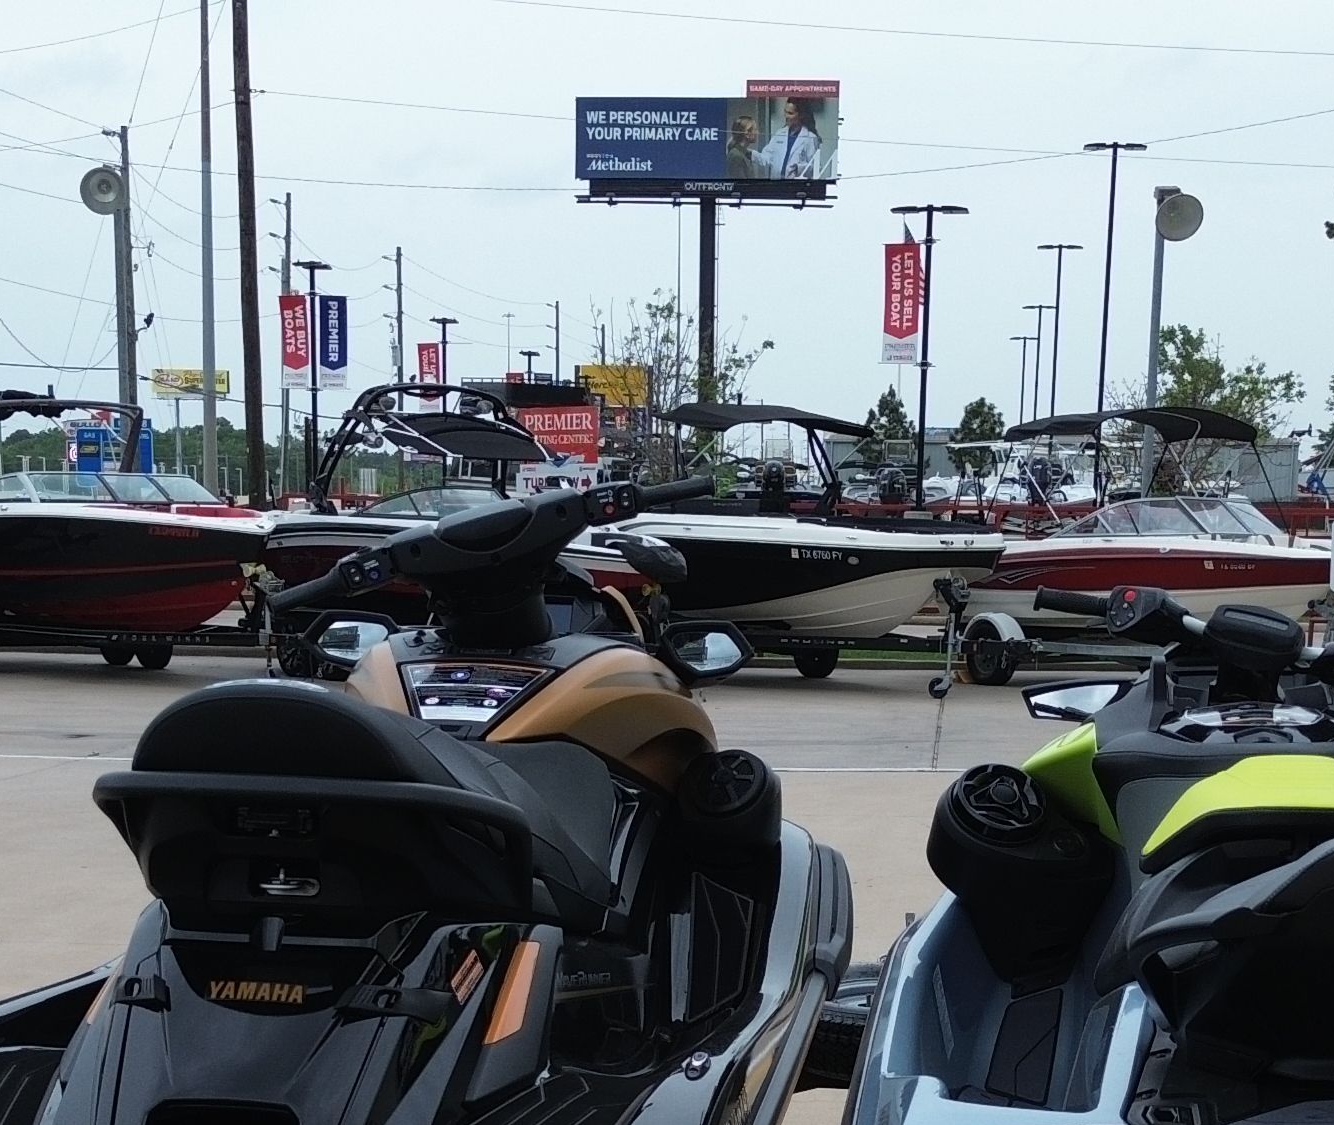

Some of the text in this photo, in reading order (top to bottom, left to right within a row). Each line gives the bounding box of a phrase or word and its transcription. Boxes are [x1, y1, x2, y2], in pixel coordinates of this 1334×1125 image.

[586, 111, 698, 125] WE PERSONALIZE
[586, 126, 719, 141] YOUR PRIMARY CARE
[587, 156, 653, 172] Methodist
[890, 255, 902, 328] YOUR BOAT
[902, 252, 914, 330] LET US SELL
[283, 309, 296, 353] BOATS
[294, 305, 307, 357] WE BUY
[327, 301, 340, 362] PREMIER
[525, 412, 594, 431] PREMIER
[800, 549, 812, 558] TX
[210, 980, 303, 1004] YAMAHA
